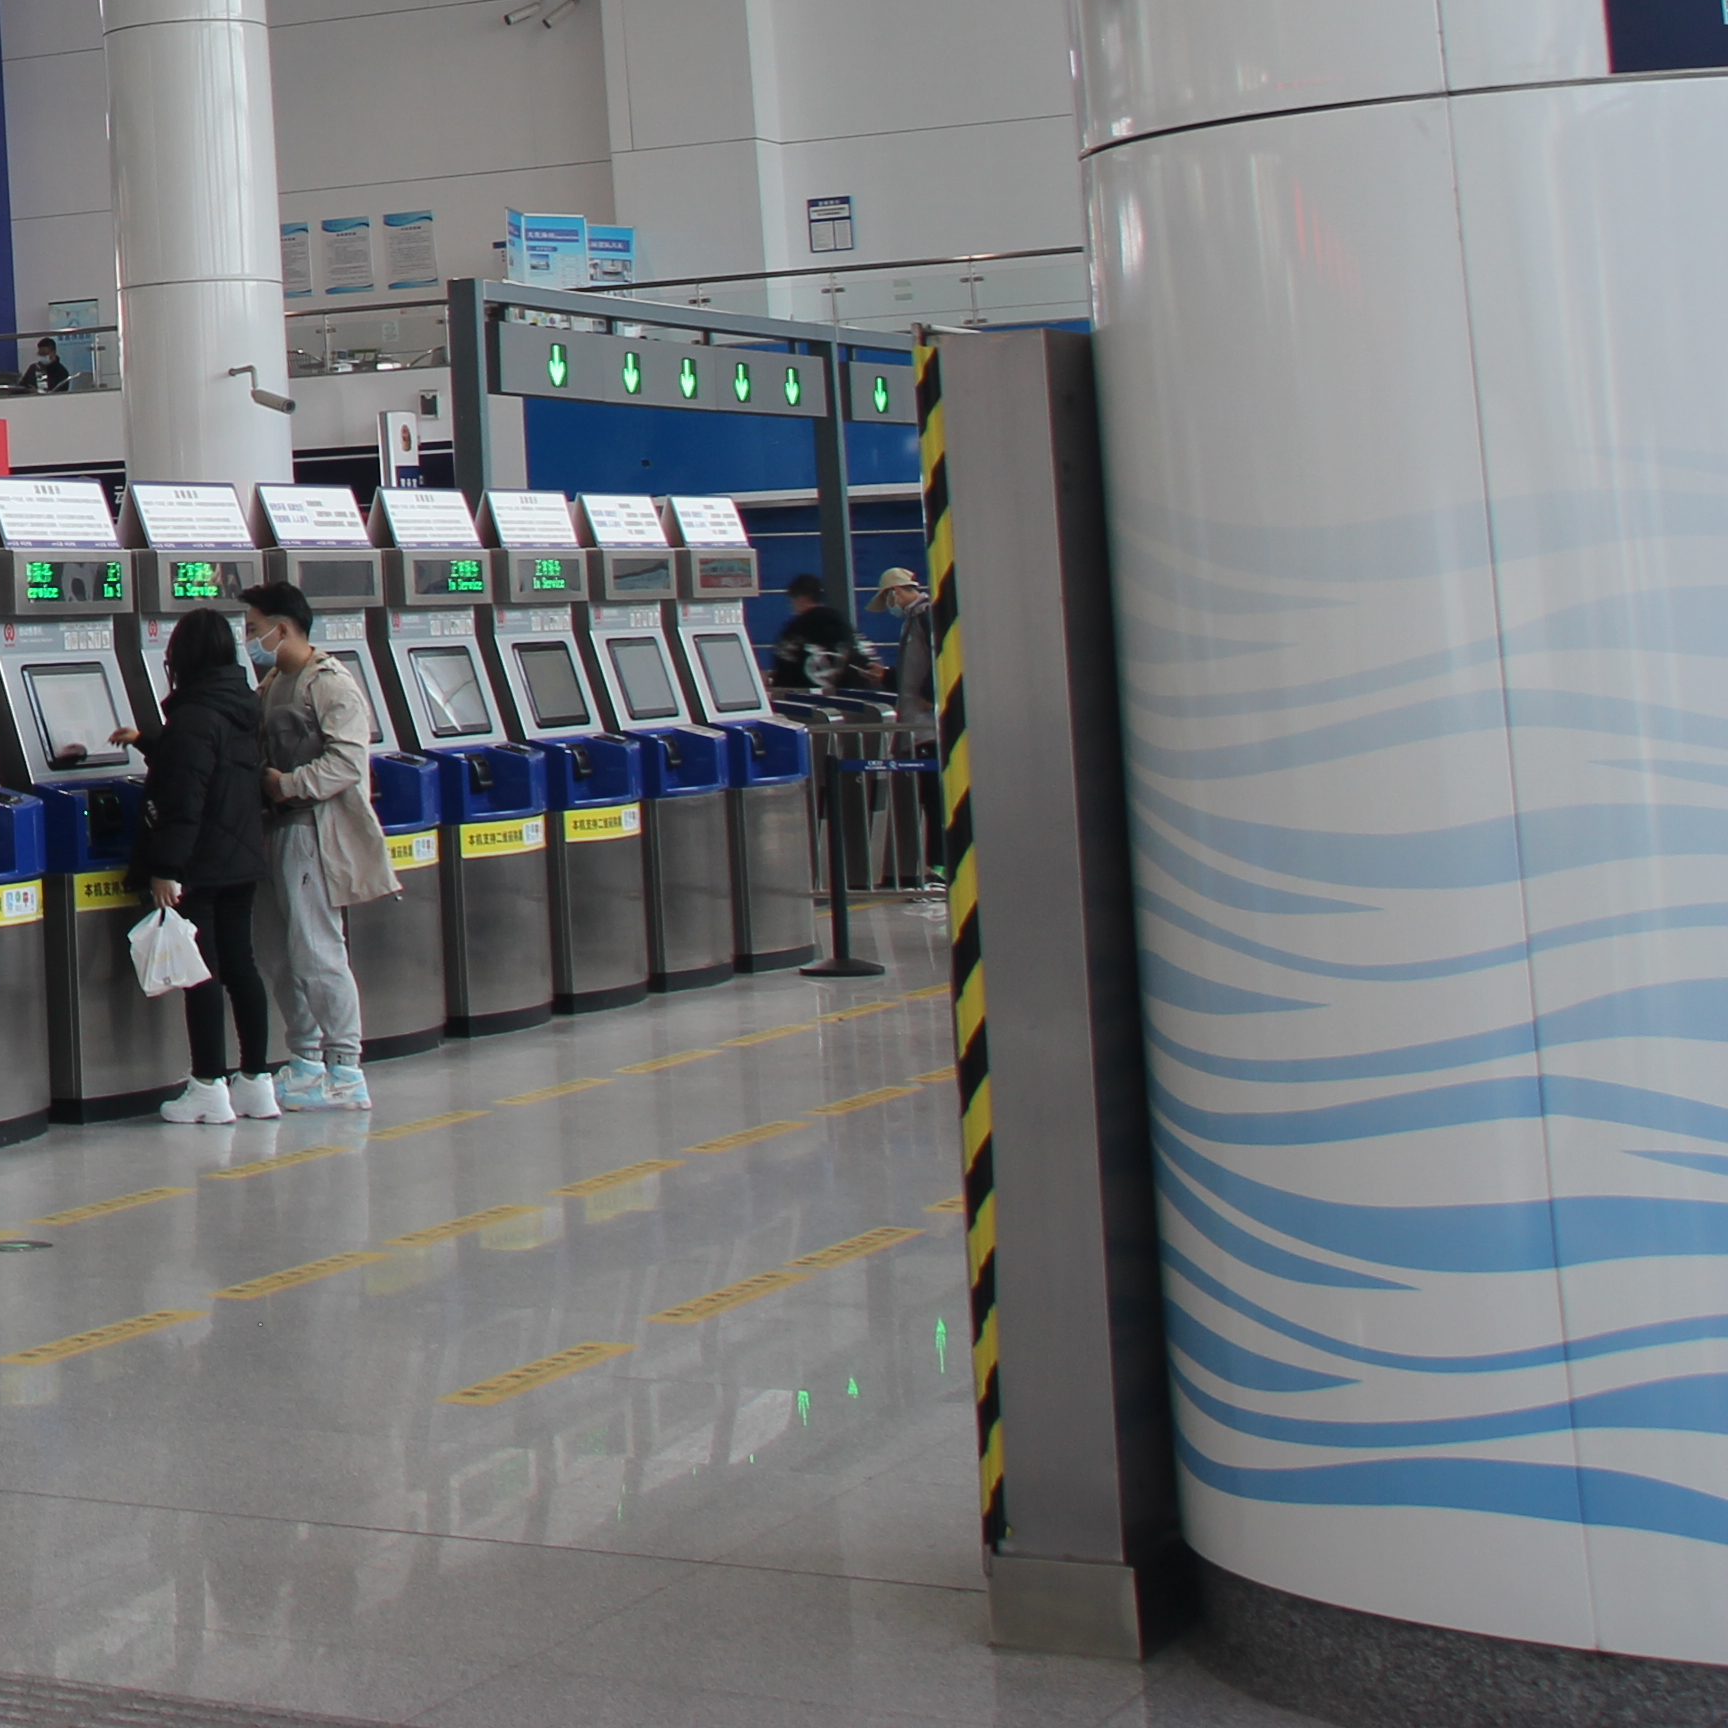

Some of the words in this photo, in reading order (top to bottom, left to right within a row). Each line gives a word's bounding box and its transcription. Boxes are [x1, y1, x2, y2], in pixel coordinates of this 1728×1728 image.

[447, 578, 456, 592] In
[457, 578, 483, 592] Service
[532, 577, 542, 590] In
[544, 576, 565, 590] Service
[174, 584, 184, 598] In
[186, 583, 218, 597] Service
